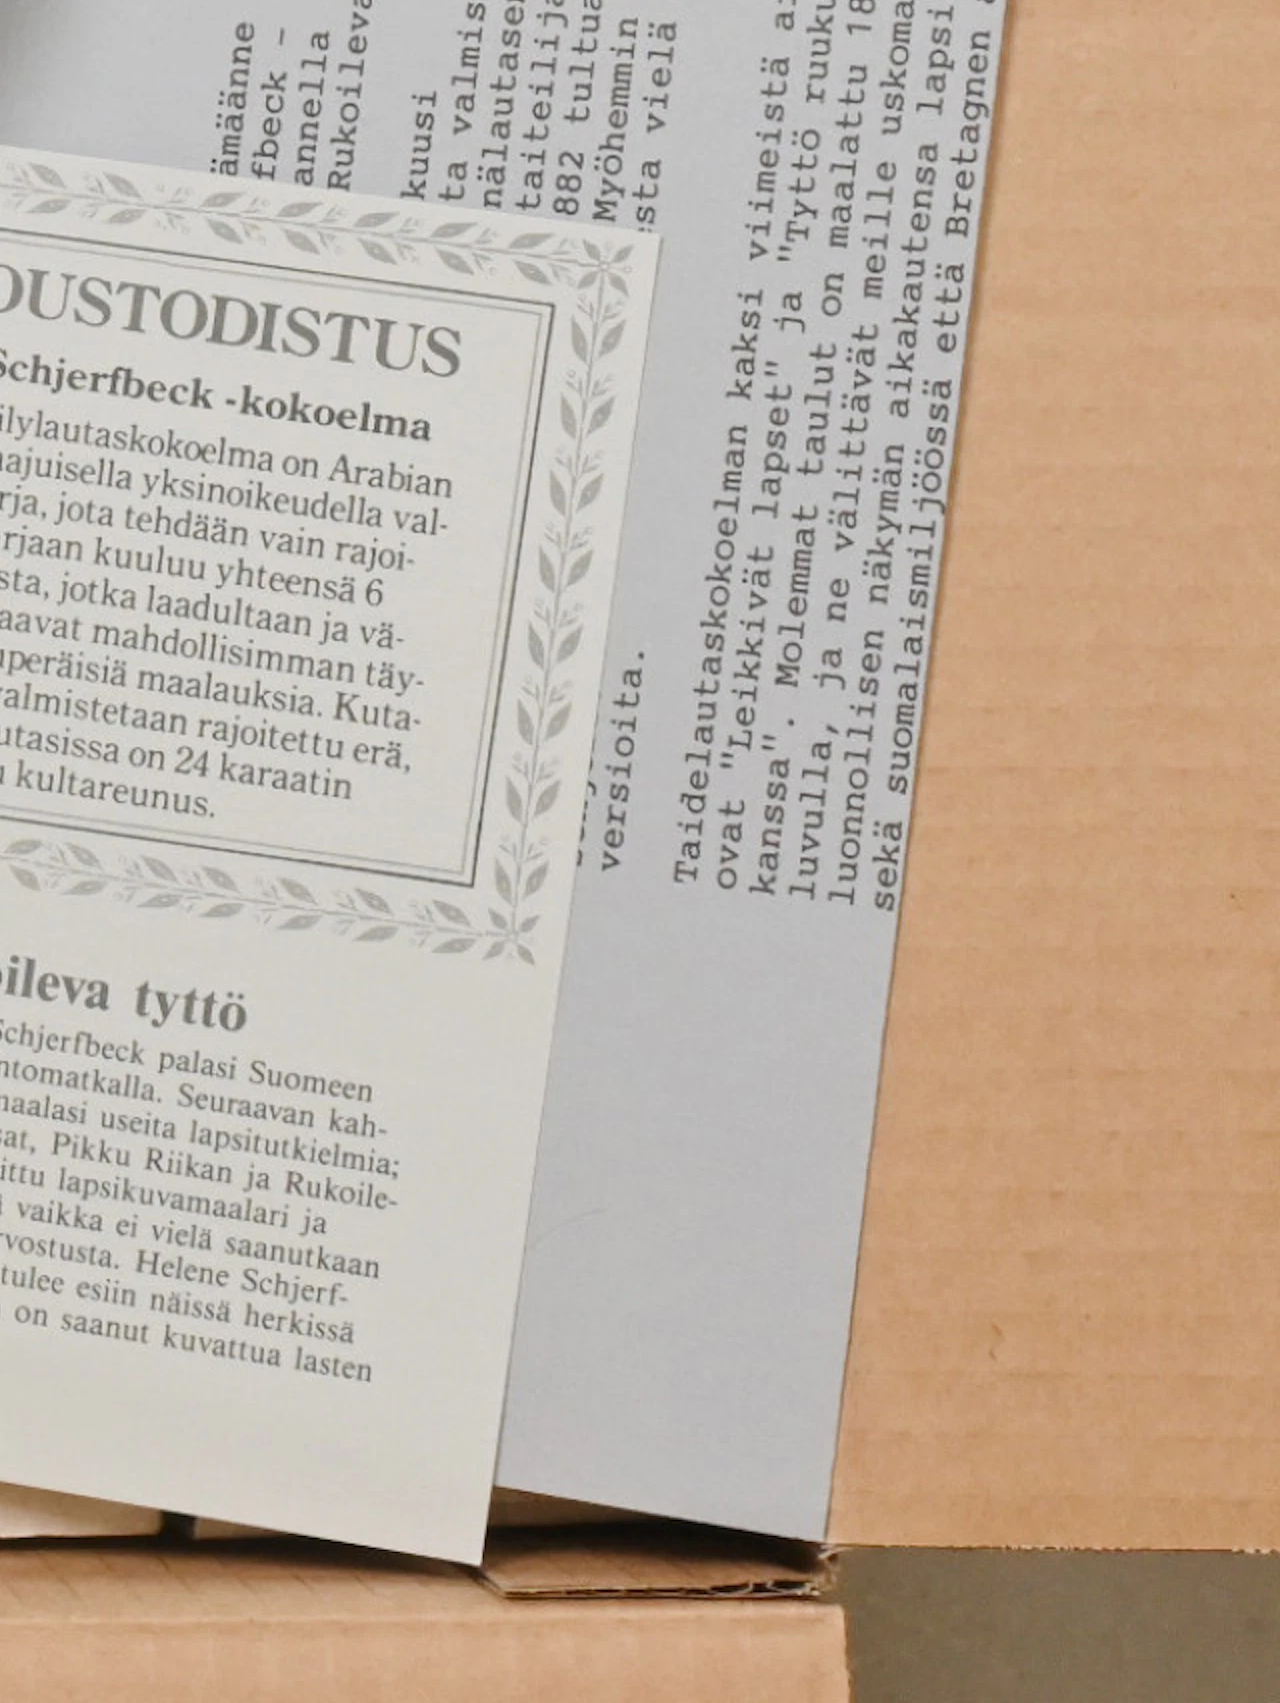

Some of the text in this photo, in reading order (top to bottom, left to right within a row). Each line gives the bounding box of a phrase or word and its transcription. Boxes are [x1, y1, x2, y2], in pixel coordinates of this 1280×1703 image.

[641, 20, 678, 135] vielä
[398, 89, 439, 202] kuusi
[590, 16, 640, 224] Myöhemmin
[743, 55, 791, 262] viimeistä
[943, 30, 992, 239] Bretagnen
[860, 160, 898, 301] meille
[724, 288, 765, 402] kaksi
[931, 262, 966, 355] että
[224, 383, 432, 443] -kokoelma
[773, 63, 869, 689] Molemmat taulut on maalattu
[280, 454, 320, 480] on
[326, 452, 453, 500] Arabian
[826, 323, 880, 553] välittävät
[52, 490, 114, 529] jota
[124, 504, 250, 548] tehdään
[258, 525, 326, 560] vain
[140, 466, 384, 529] yksinoikeudella
[826, 629, 886, 907] luonnollisen
[860, 443, 906, 606] näkymän
[884, 142, 940, 420] aikakautensa
[55, 570, 137, 611] jotka
[146, 583, 313, 638] laadultaan
[317, 609, 349, 647] ja
[92, 535, 207, 581] kuuluu
[214, 556, 357, 605] yhteensä
[715, 798, 747, 891] ovat
[771, 290, 807, 335] ja
[825, 577, 852, 624] ne
[886, 378, 953, 796] suomalaismiljöössä
[90, 621, 356, 685] mahdollisimman
[671, 423, 750, 885] Taidelautaskokoelman
[811, 646, 848, 692] ja
[135, 669, 323, 718] maalauksia.
[332, 689, 421, 733] Kuta-
[127, 745, 166, 772] on
[172, 744, 210, 779] 24
[218, 750, 353, 801] karaatin
[196, 714, 346, 761] rajoitettu
[351, 740, 412, 774] erä,
[600, 650, 646, 873] versioita.
[14, 758, 216, 819] kultareunus.
[786, 723, 841, 902] luvulla,
[870, 819, 904, 913] sekä
[134, 980, 248, 1033] tyttö
[156, 1049, 238, 1082] palasi
[247, 1059, 374, 1104] Suomeen
[176, 1081, 316, 1129] Seuraavan
[51, 1130, 131, 1169] Pikku
[143, 1146, 233, 1185] Riikan
[242, 1163, 271, 1194] ja
[283, 1169, 398, 1211] Rukoile-
[100, 1110, 177, 1141] useita
[189, 1118, 400, 1181] lapsitutkielmia;
[16, 1199, 104, 1233] vaikka
[114, 1213, 139, 1239] ei
[150, 1219, 213, 1252] vielä
[224, 1236, 380, 1280] saanutkaan
[57, 1165, 290, 1229] lapsikuvamaalari
[298, 1207, 328, 1238] ja
[0, 1264, 66, 1296] tulee
[75, 1277, 137, 1308] esiin
[149, 1290, 231, 1324] näissä
[243, 1301, 355, 1345] herkissä
[134, 1248, 231, 1289] Helene
[13, 1304, 49, 1328] on
[59, 1312, 150, 1345] saanut
[162, 1322, 282, 1368] kuvattua
[294, 1345, 373, 1384] lasten
